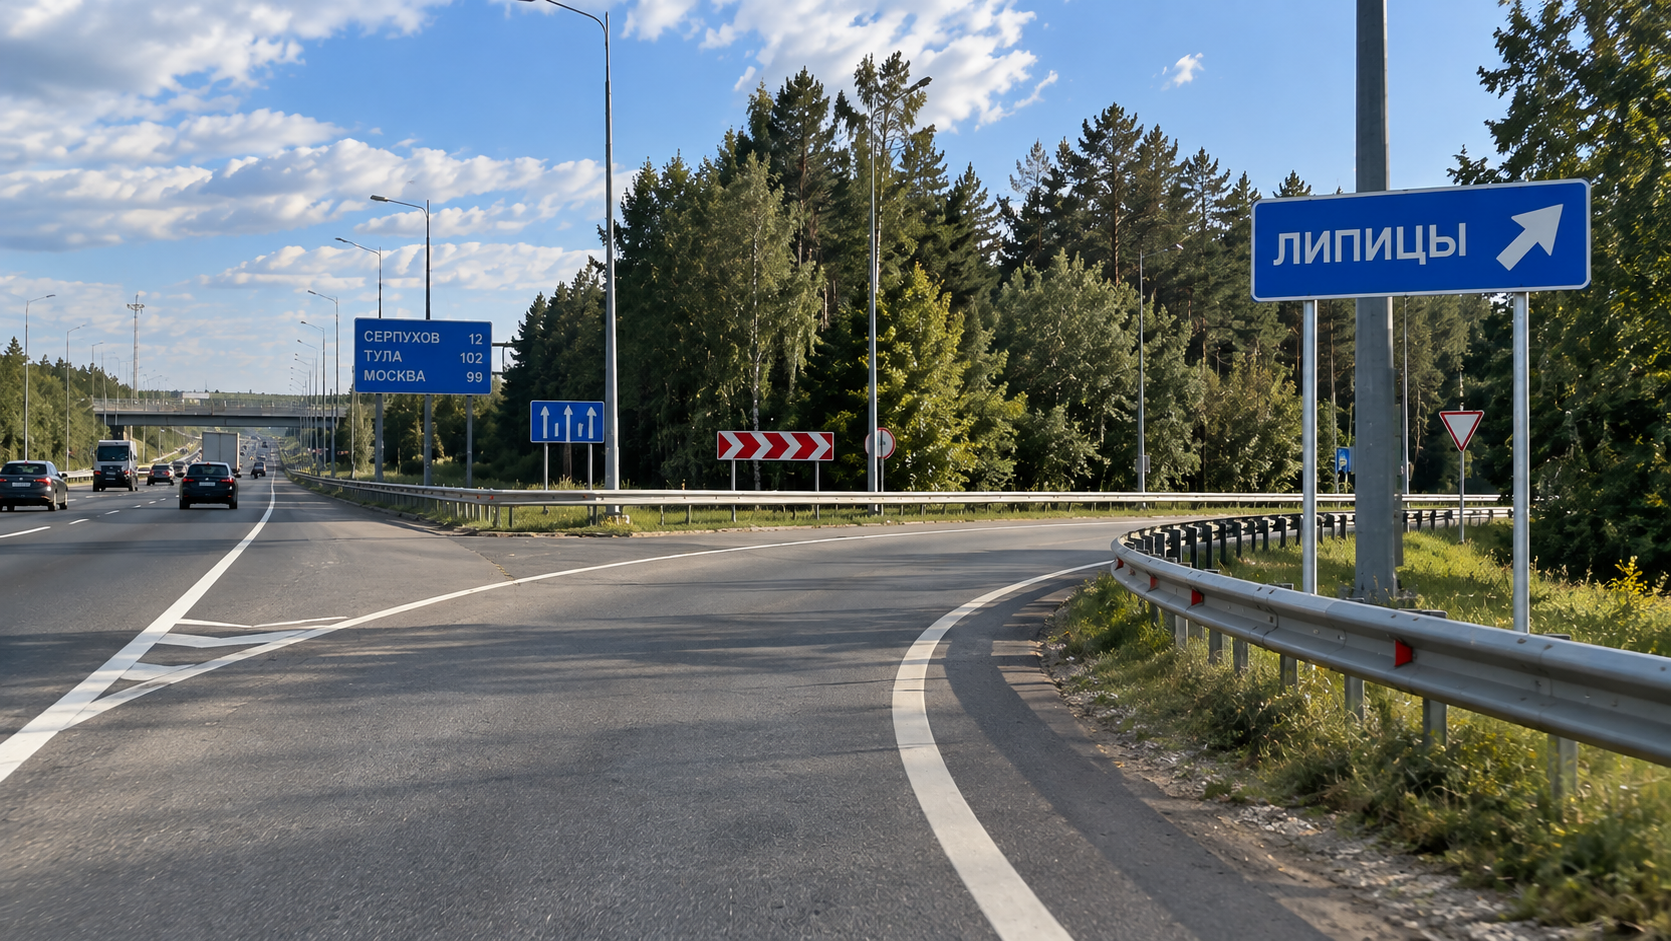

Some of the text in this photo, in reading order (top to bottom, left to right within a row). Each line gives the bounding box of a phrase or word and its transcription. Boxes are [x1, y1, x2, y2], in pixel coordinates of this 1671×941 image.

[1273, 222, 1467, 266] ЛИПИЦЫ
[364, 331, 483, 345] СЕРПУХОВ 12
[364, 350, 483, 364] ТУЛА 102
[364, 370, 483, 383] МОСКВА 99
